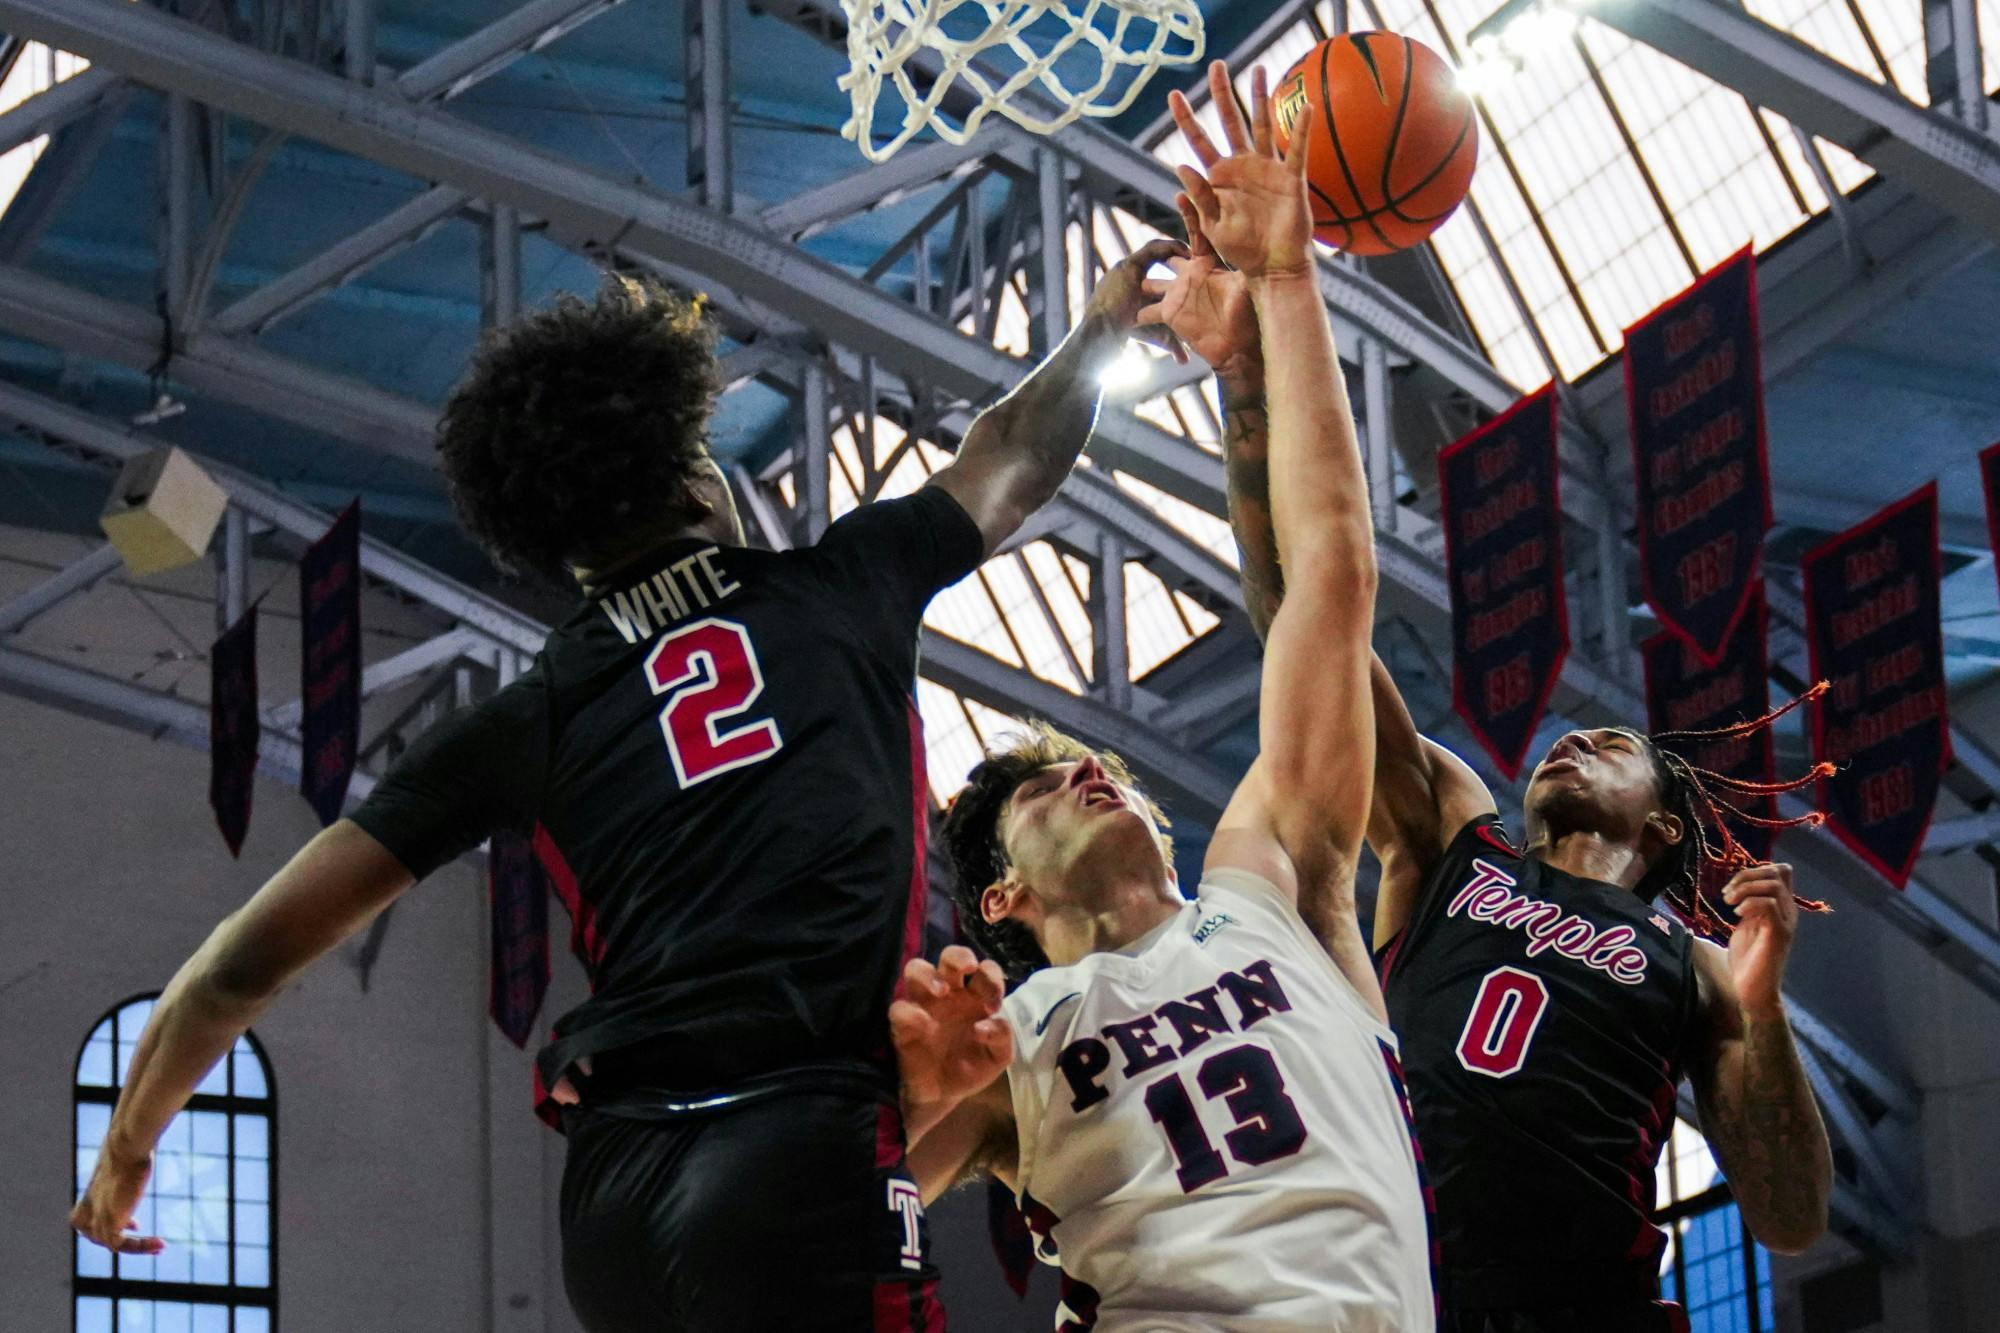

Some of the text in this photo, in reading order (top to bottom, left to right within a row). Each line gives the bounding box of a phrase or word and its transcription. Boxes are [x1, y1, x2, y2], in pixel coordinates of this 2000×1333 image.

[600, 546, 741, 644] WHITE
[643, 617, 783, 790] 2
[1447, 858, 1648, 985] Temple
[1056, 959, 1293, 1114] PENN
[1455, 965, 1549, 1078] 0
[1144, 1043, 1308, 1194] 13
